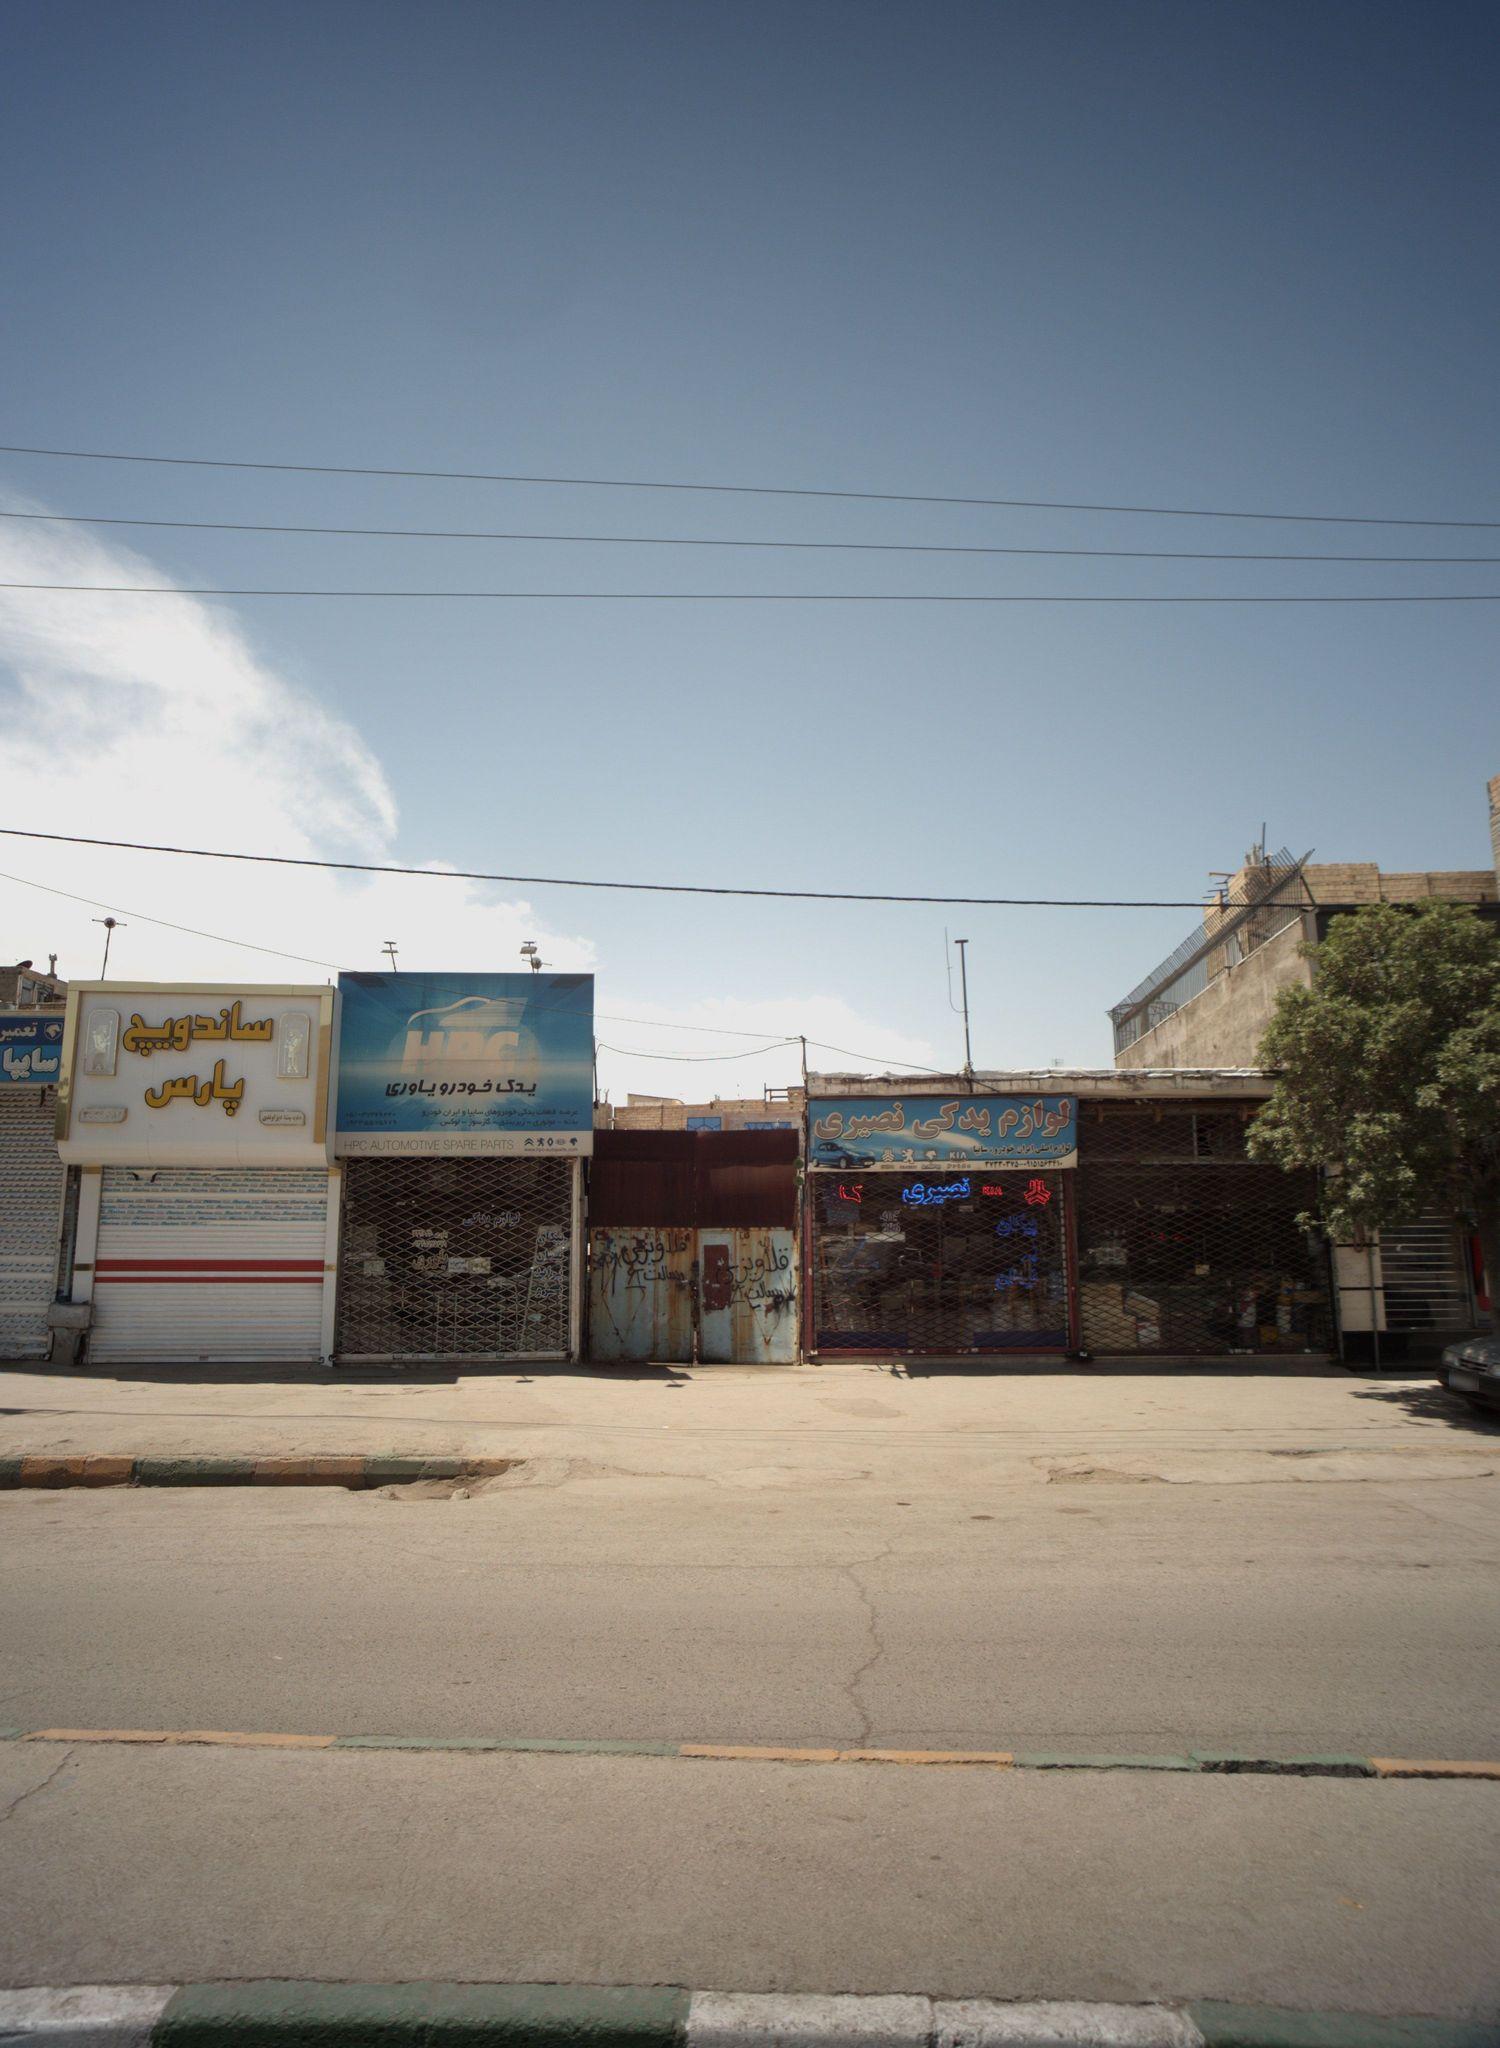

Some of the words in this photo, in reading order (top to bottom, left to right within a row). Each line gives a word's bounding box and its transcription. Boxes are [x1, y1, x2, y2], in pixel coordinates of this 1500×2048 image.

[123, 1000, 274, 1057] ساندویچ
[3, 1046, 59, 1081] سایپا
[401, 1030, 519, 1075] HPC
[145, 1058, 245, 1117] پارس
[385, 1079, 436, 1097] یاوری
[440, 1079, 493, 1096] خودرو
[496, 1079, 538, 1097] یدک
[814, 1102, 906, 1140] نصیری
[912, 1101, 991, 1139] یدکی
[998, 1099, 1072, 1138] لوازم
[344, 1140, 367, 1150] HPC
[370, 1139, 440, 1151] AUTOMOTIVE
[443, 1139, 477, 1151] SPARE
[480, 1139, 514, 1151] PARTS
[949, 1151, 967, 1160] KIA
[902, 1177, 971, 1205] نصیری
